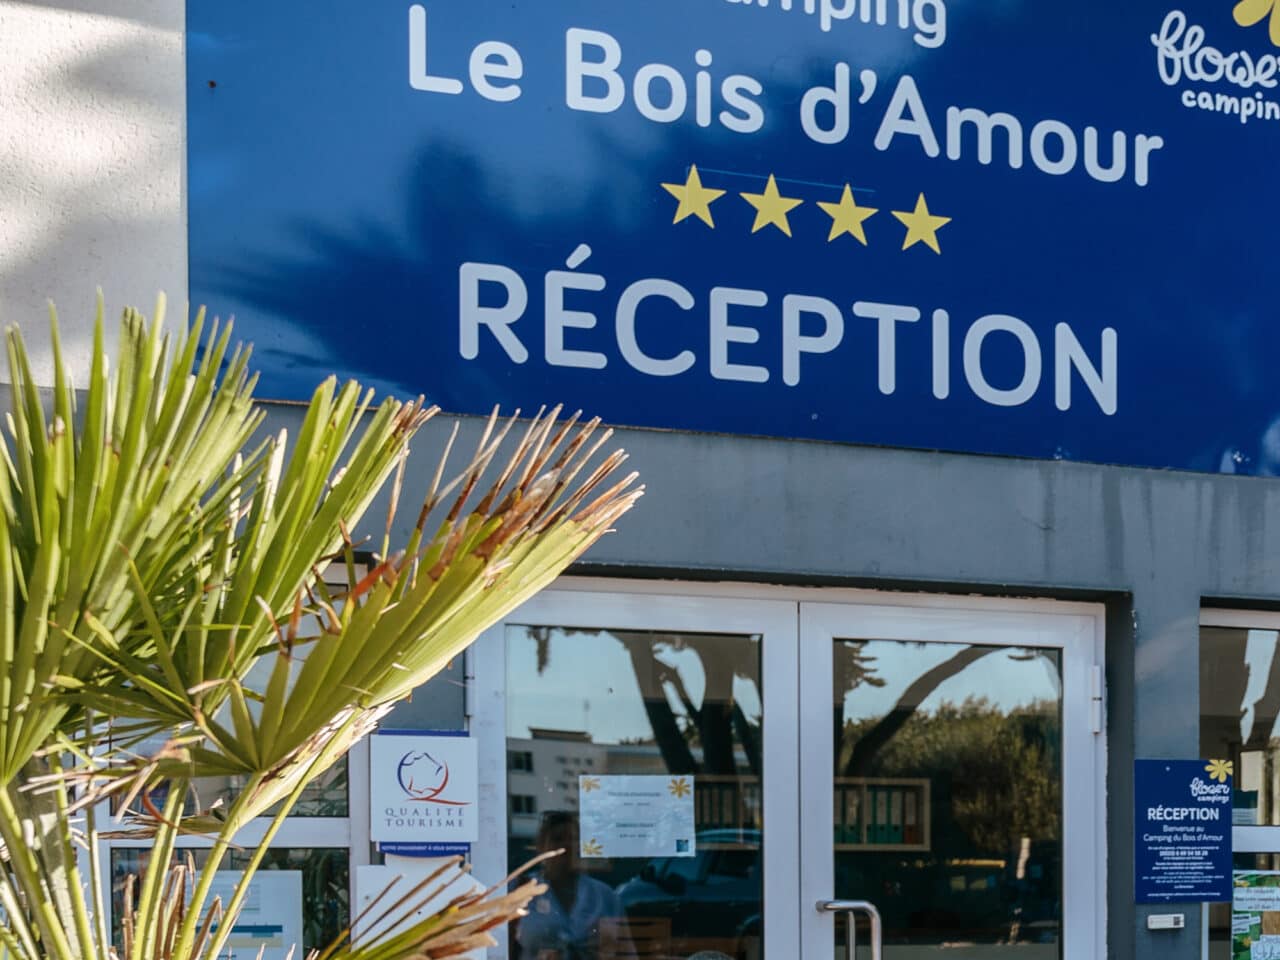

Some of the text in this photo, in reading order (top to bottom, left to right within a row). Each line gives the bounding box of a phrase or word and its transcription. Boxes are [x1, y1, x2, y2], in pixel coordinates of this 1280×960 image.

[408, 4, 524, 102] Le
[565, 28, 764, 134] Bois
[459, 243, 1118, 416] RÉCEPTION
[1147, 804, 1219, 821] RÉCEPTION
[385, 818, 464, 827] TOURISME
[1143, 833, 1172, 843] Camping
[1173, 833, 1181, 841] du
